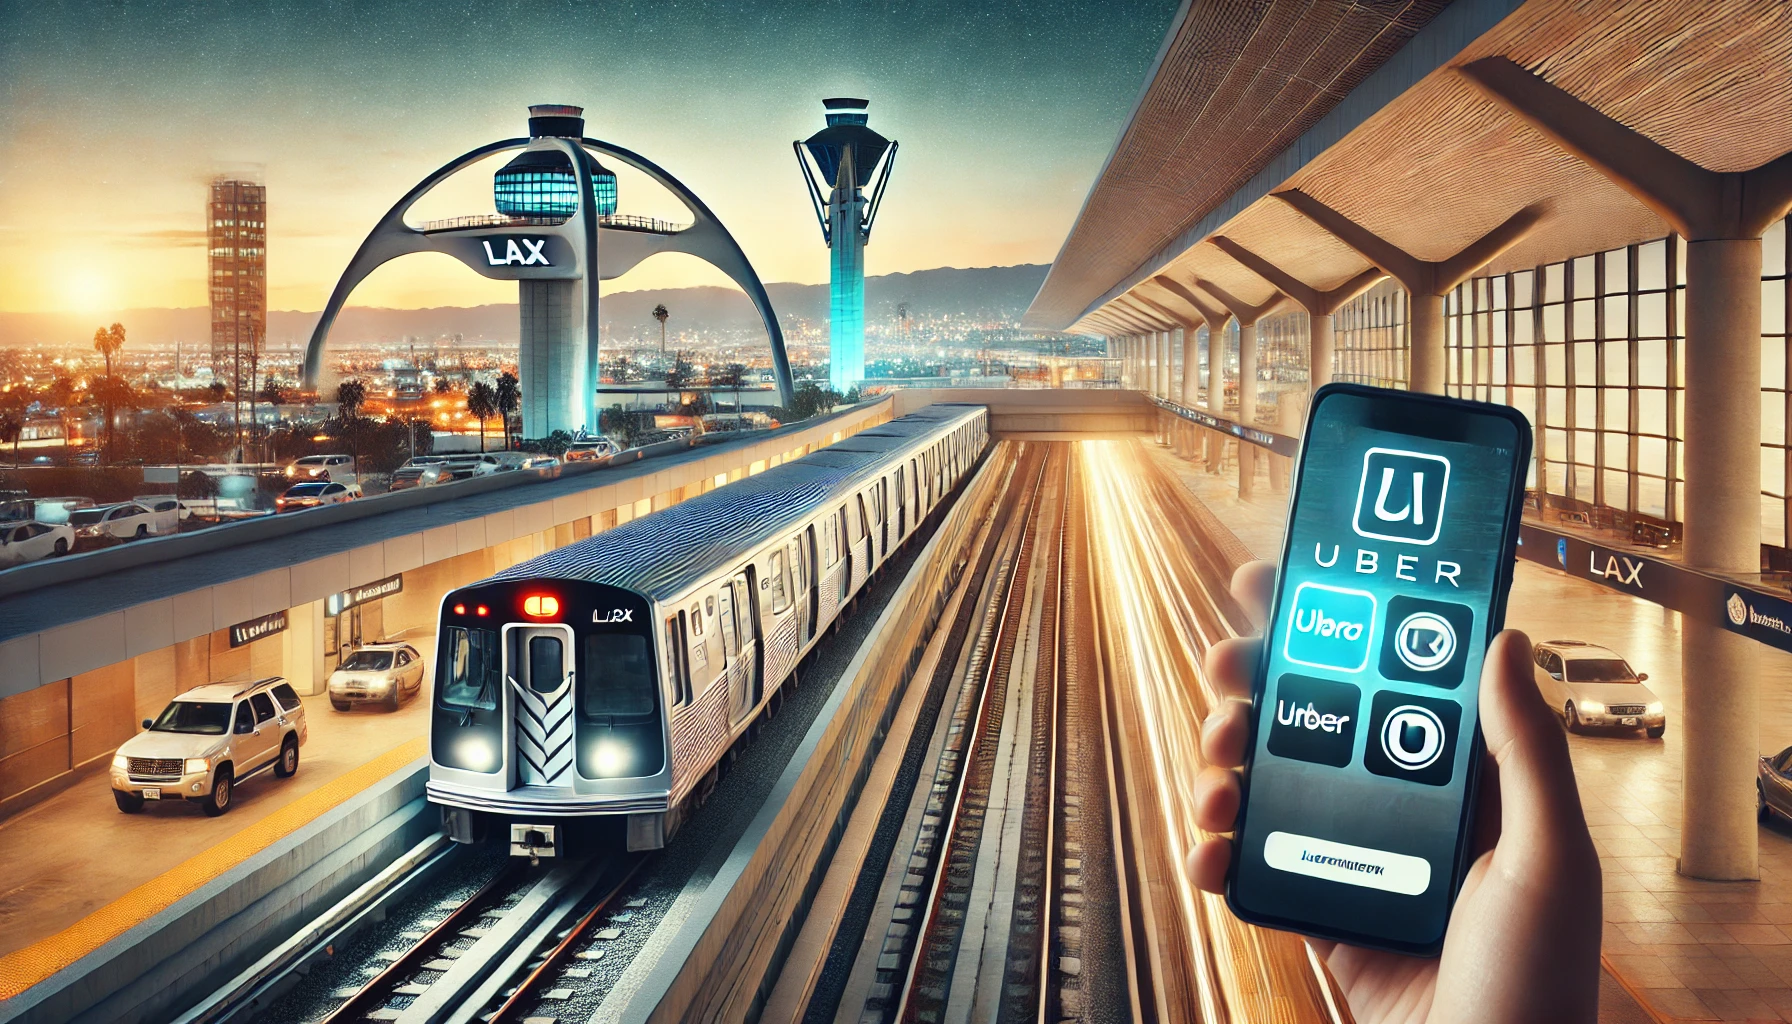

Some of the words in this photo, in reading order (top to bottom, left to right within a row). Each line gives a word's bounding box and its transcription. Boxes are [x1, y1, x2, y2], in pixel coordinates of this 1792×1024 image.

[482, 238, 550, 266] LAX
[1314, 541, 1462, 588] UBER
[1590, 550, 1644, 589] LAX
